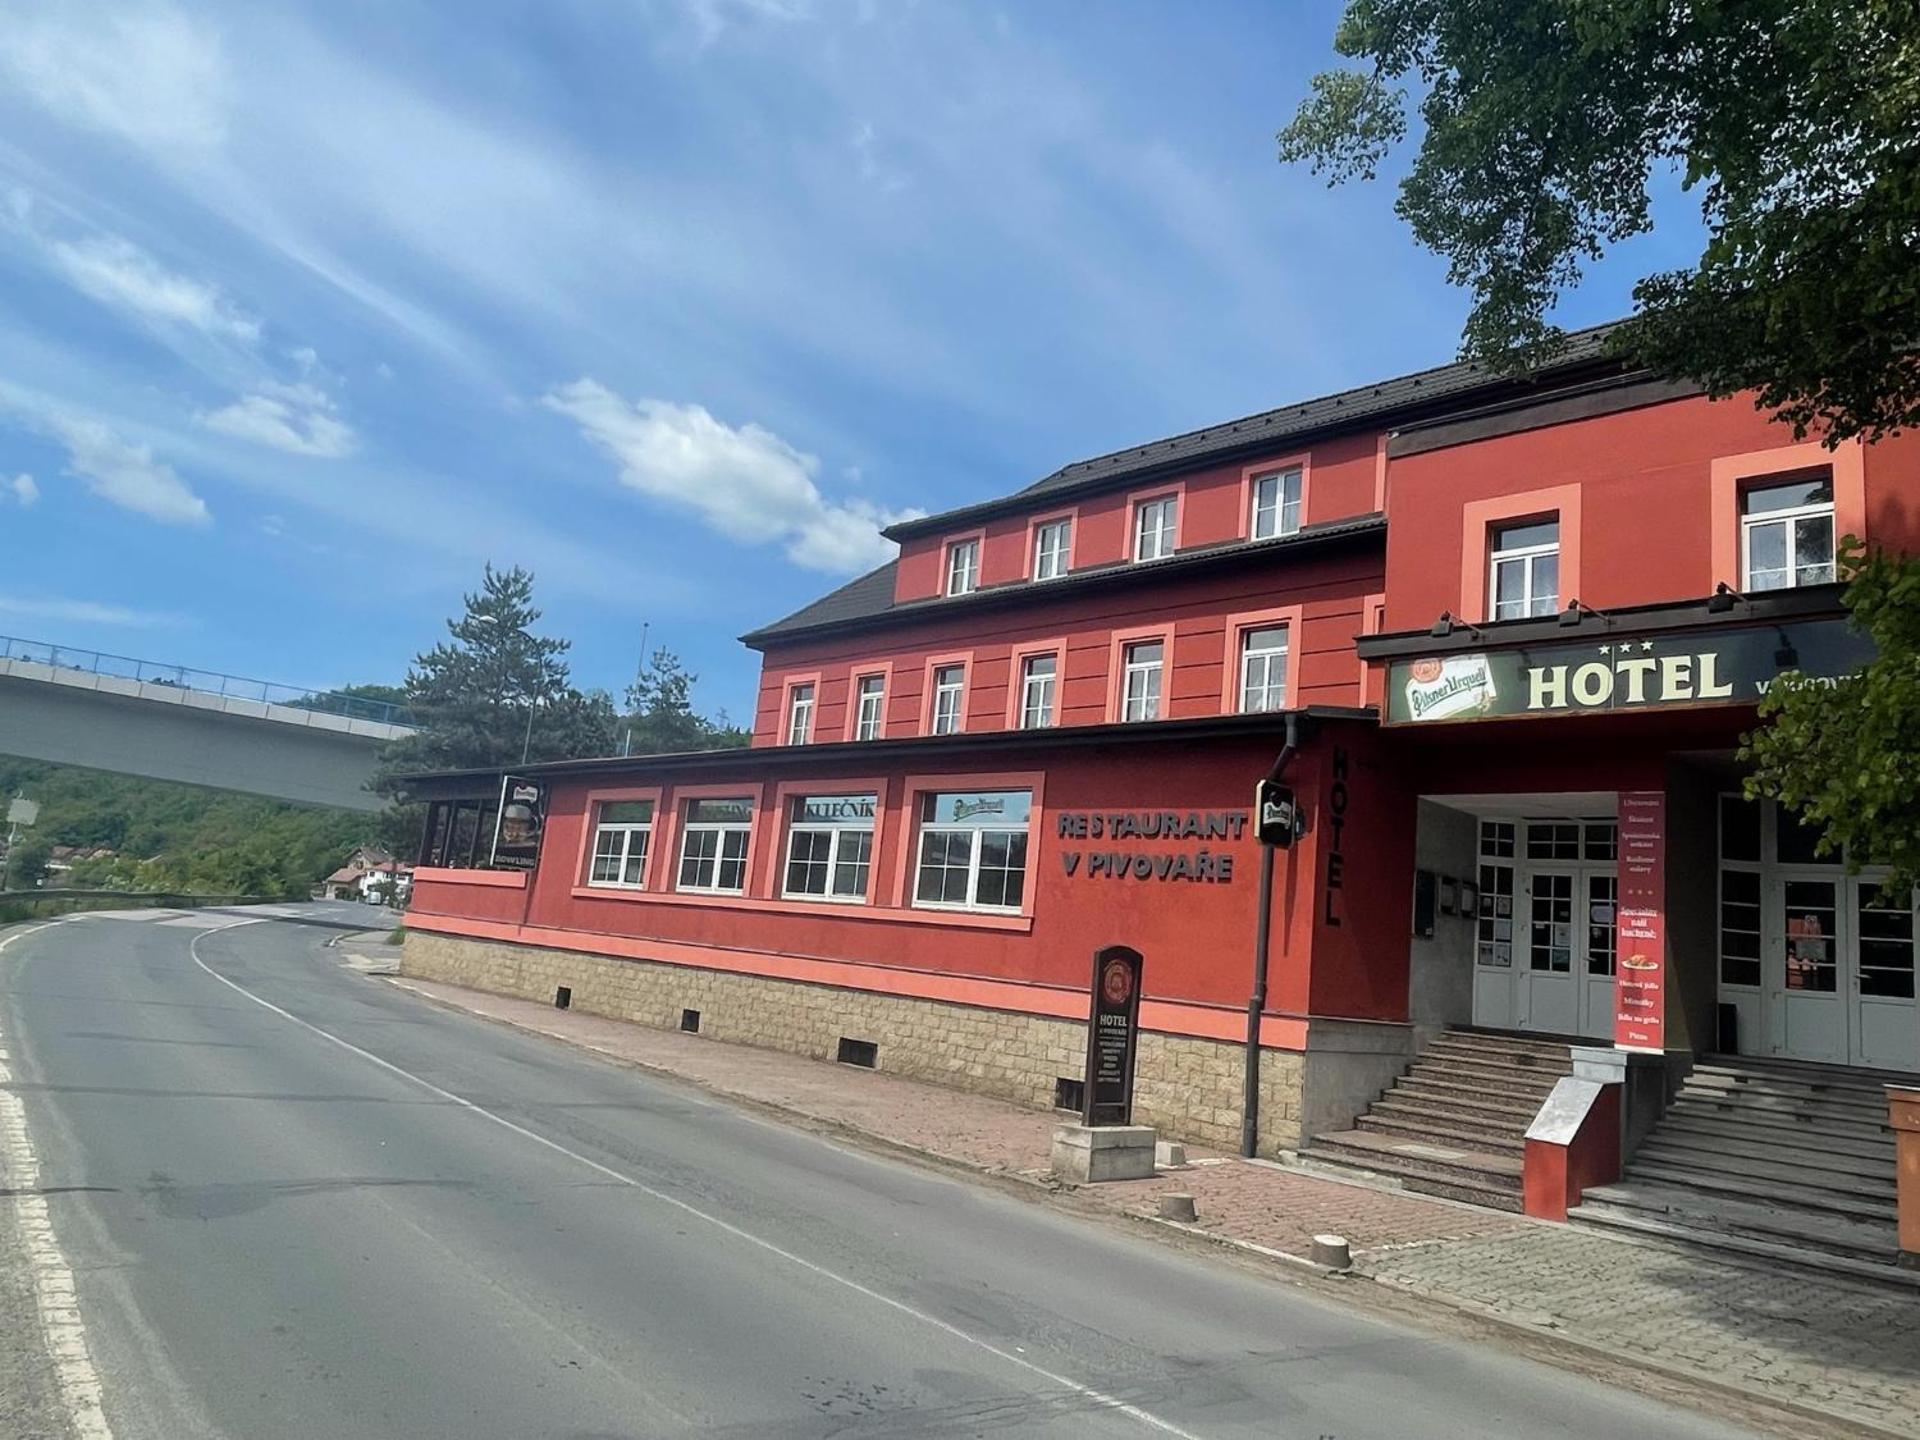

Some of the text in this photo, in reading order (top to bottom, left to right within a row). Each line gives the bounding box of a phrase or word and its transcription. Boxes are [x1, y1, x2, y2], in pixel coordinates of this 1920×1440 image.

[1527, 653, 1733, 709] HOTEL
[1412, 684, 1448, 717] Pilsner
[1058, 811, 1249, 840] RESTAURANT
[1326, 745, 1347, 927] HOTEL
[1062, 848, 1233, 883] V PIVOVAŘE
[1100, 1014, 1127, 1027] HOTEL
